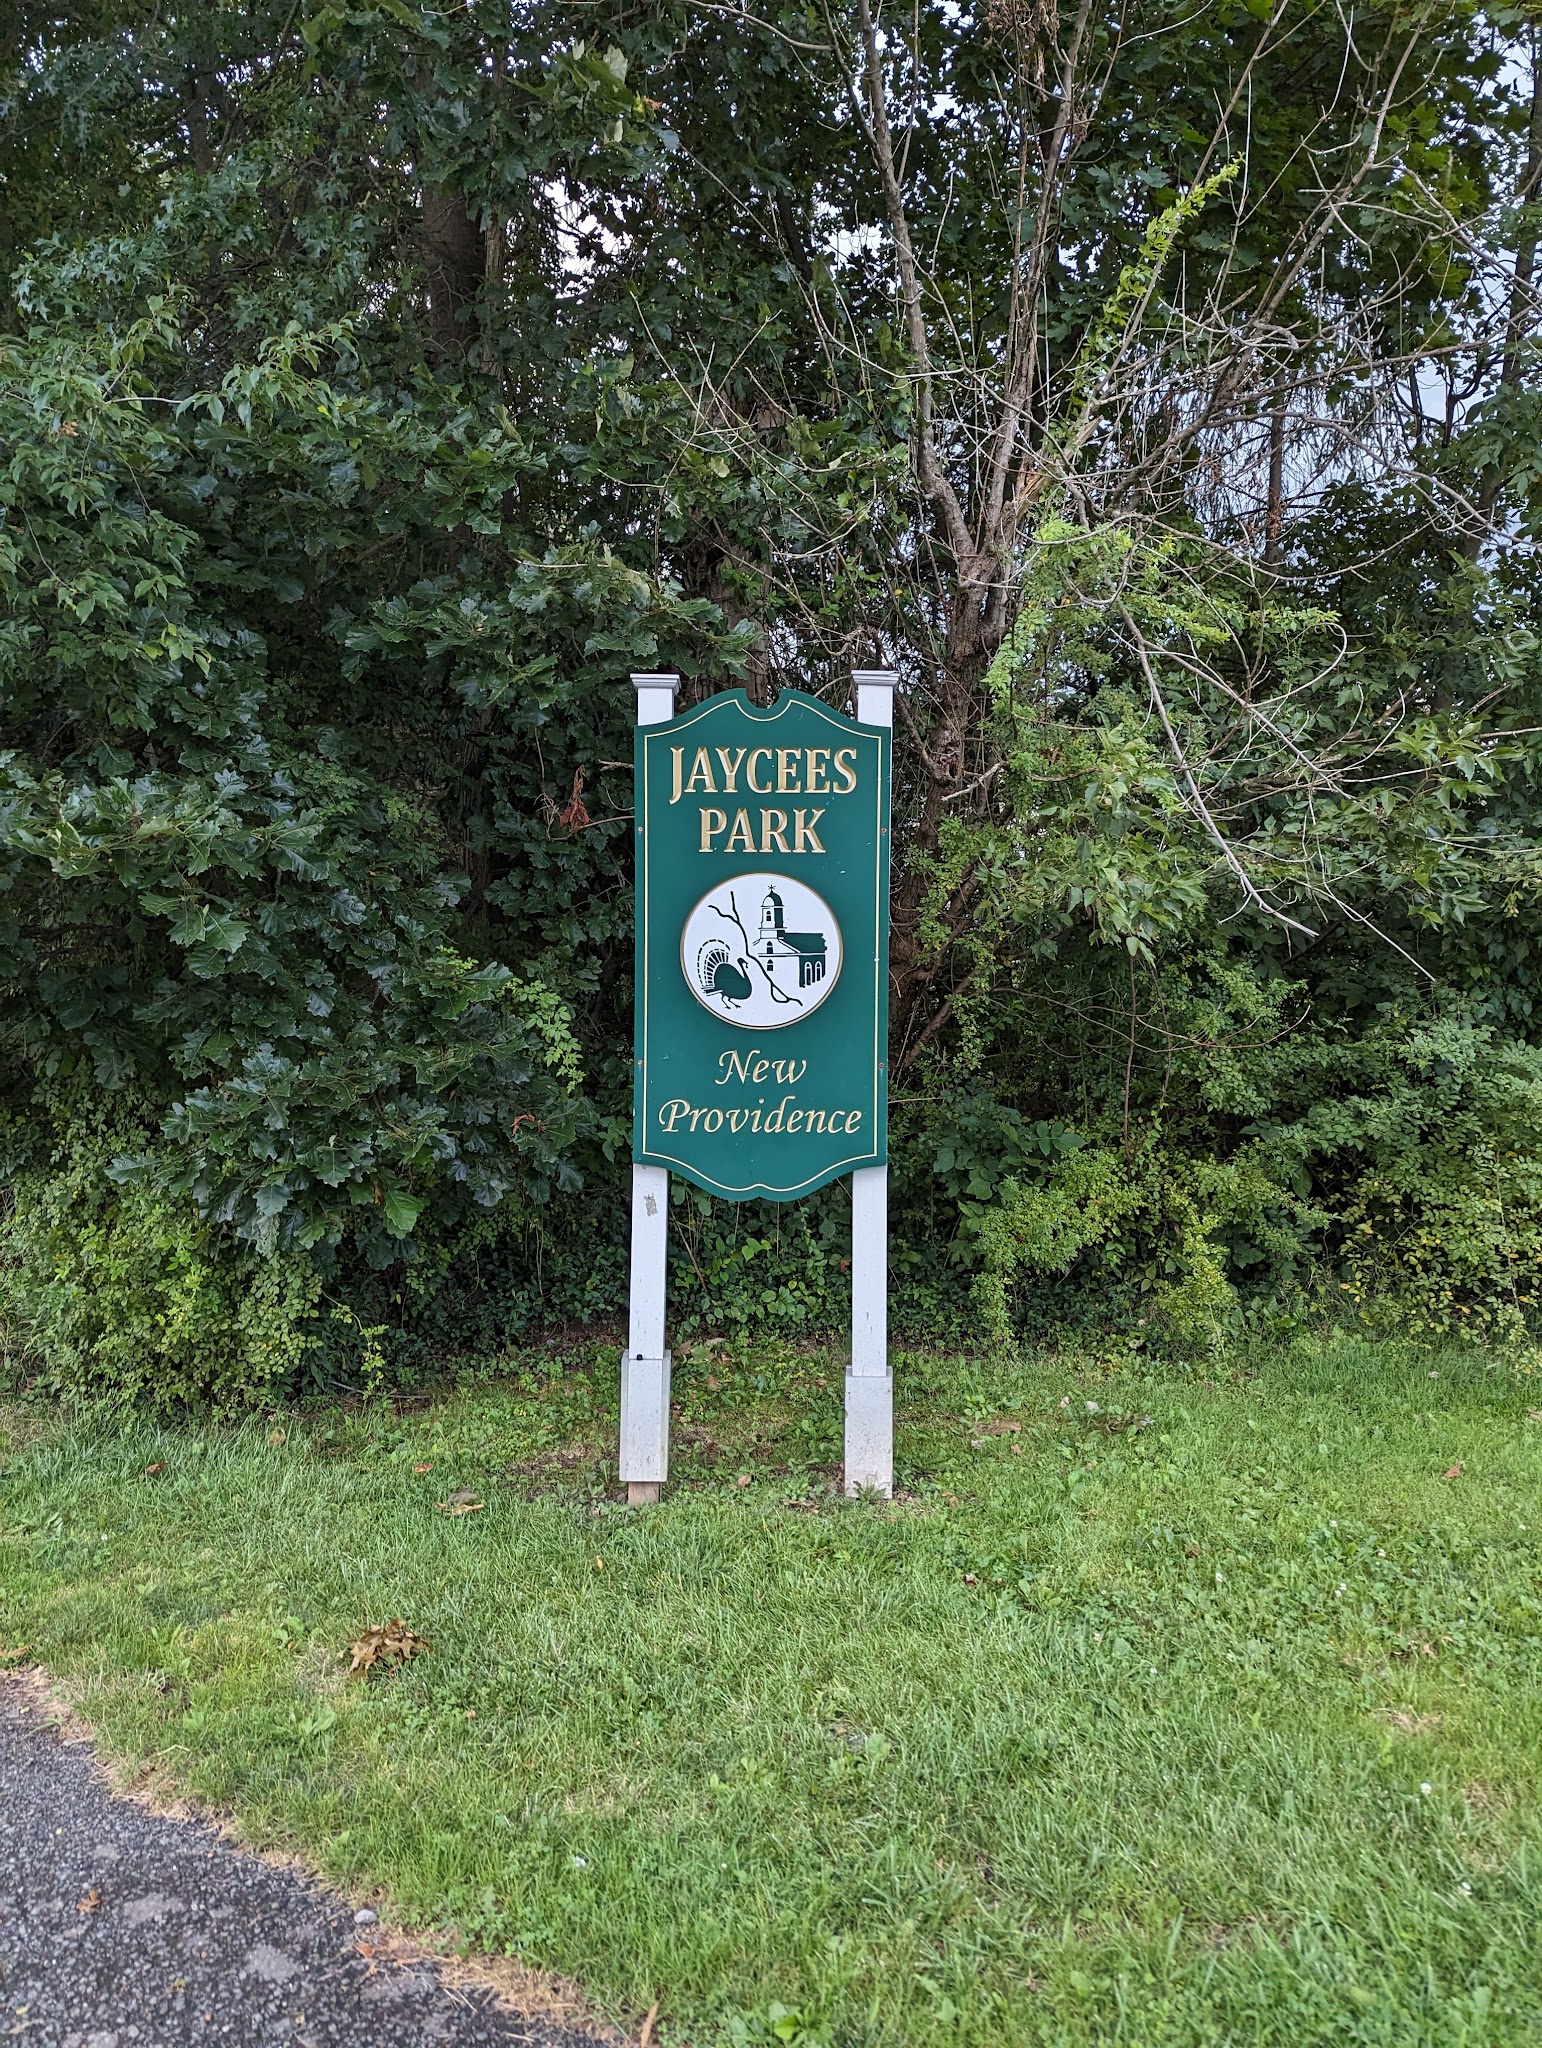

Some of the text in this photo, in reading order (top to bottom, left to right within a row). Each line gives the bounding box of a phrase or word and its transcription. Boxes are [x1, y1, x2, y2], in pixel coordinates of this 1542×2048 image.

[669, 746, 857, 805] JAYCEES
[698, 807, 827, 854] PARK
[714, 1049, 807, 1085] New
[658, 1095, 862, 1134] Providence
